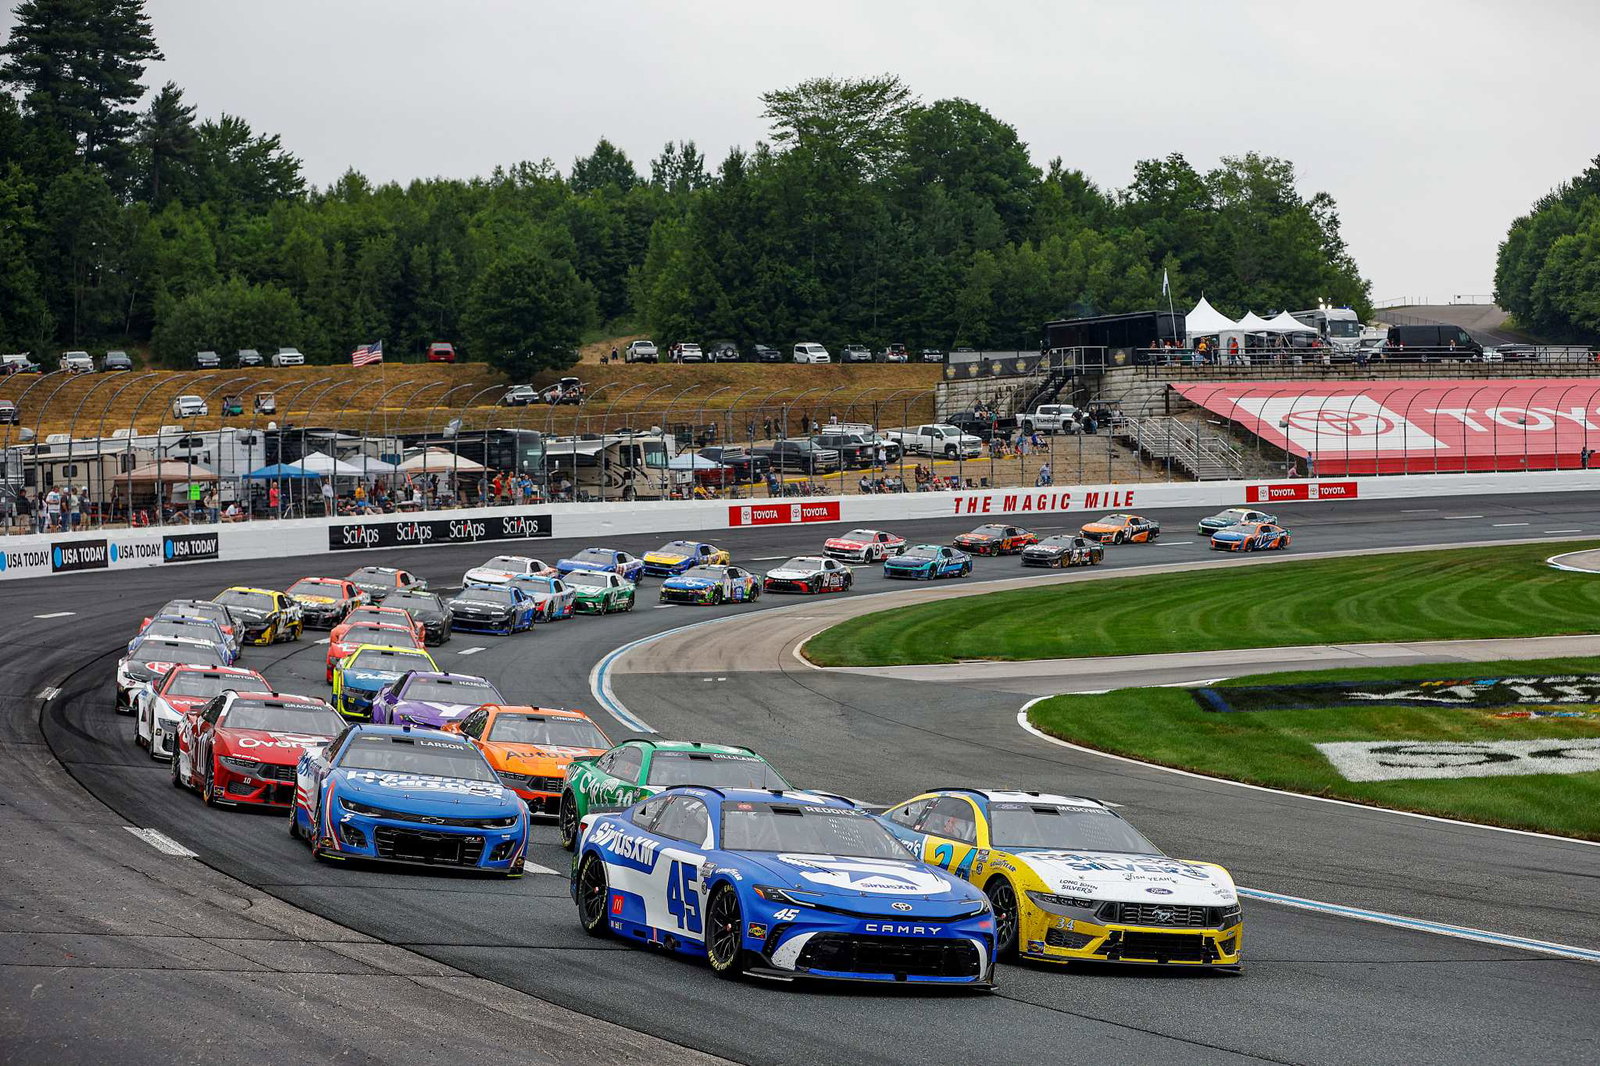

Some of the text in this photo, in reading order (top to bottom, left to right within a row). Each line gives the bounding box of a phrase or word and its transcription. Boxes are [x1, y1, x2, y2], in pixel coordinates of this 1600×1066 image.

[1425, 405, 1599, 431] TOY
[1270, 488, 1295, 497] TOYOTA
[1320, 486, 1346, 495] TOYOTA
[954, 491, 1135, 514] THE MAGIC MILE
[753, 509, 778, 519] TOYOTA
[802, 507, 828, 517] TOYOTA
[397, 522, 432, 544] SciAps
[450, 520, 485, 542] SciAps
[503, 517, 538, 538] SciAps
[1123, 527, 1132, 538] 31
[343, 525, 379, 547] SciAps
[173, 538, 217, 556] USA TODAY
[874, 544, 880, 556] 6
[1002, 539, 1012, 550] 42
[62, 546, 106, 564] USA TODAY
[118, 543, 161, 559] USA TODAY
[1072, 549, 1080, 560] 15
[7, 551, 49, 568] USA TODAY
[937, 559, 948, 572] 77
[822, 572, 830, 587] 19
[225, 673, 256, 681] BURTON
[459, 680, 490, 688] HAMLIN
[285, 703, 323, 711] GRAGSON
[420, 740, 464, 751] LARSON
[713, 753, 762, 763] GILLILAND
[804, 805, 860, 817] REDDICK
[340, 813, 355, 822] 5
[589, 822, 660, 866] SiriusXM
[861, 882, 918, 891] SiriusXM
[1059, 879, 1078, 887] LONG
[1061, 884, 1093, 894] SILVER'S
[667, 859, 703, 934] 45
[773, 908, 800, 921] 45
[865, 923, 942, 936] CAMRY
[1057, 918, 1075, 931] 34
